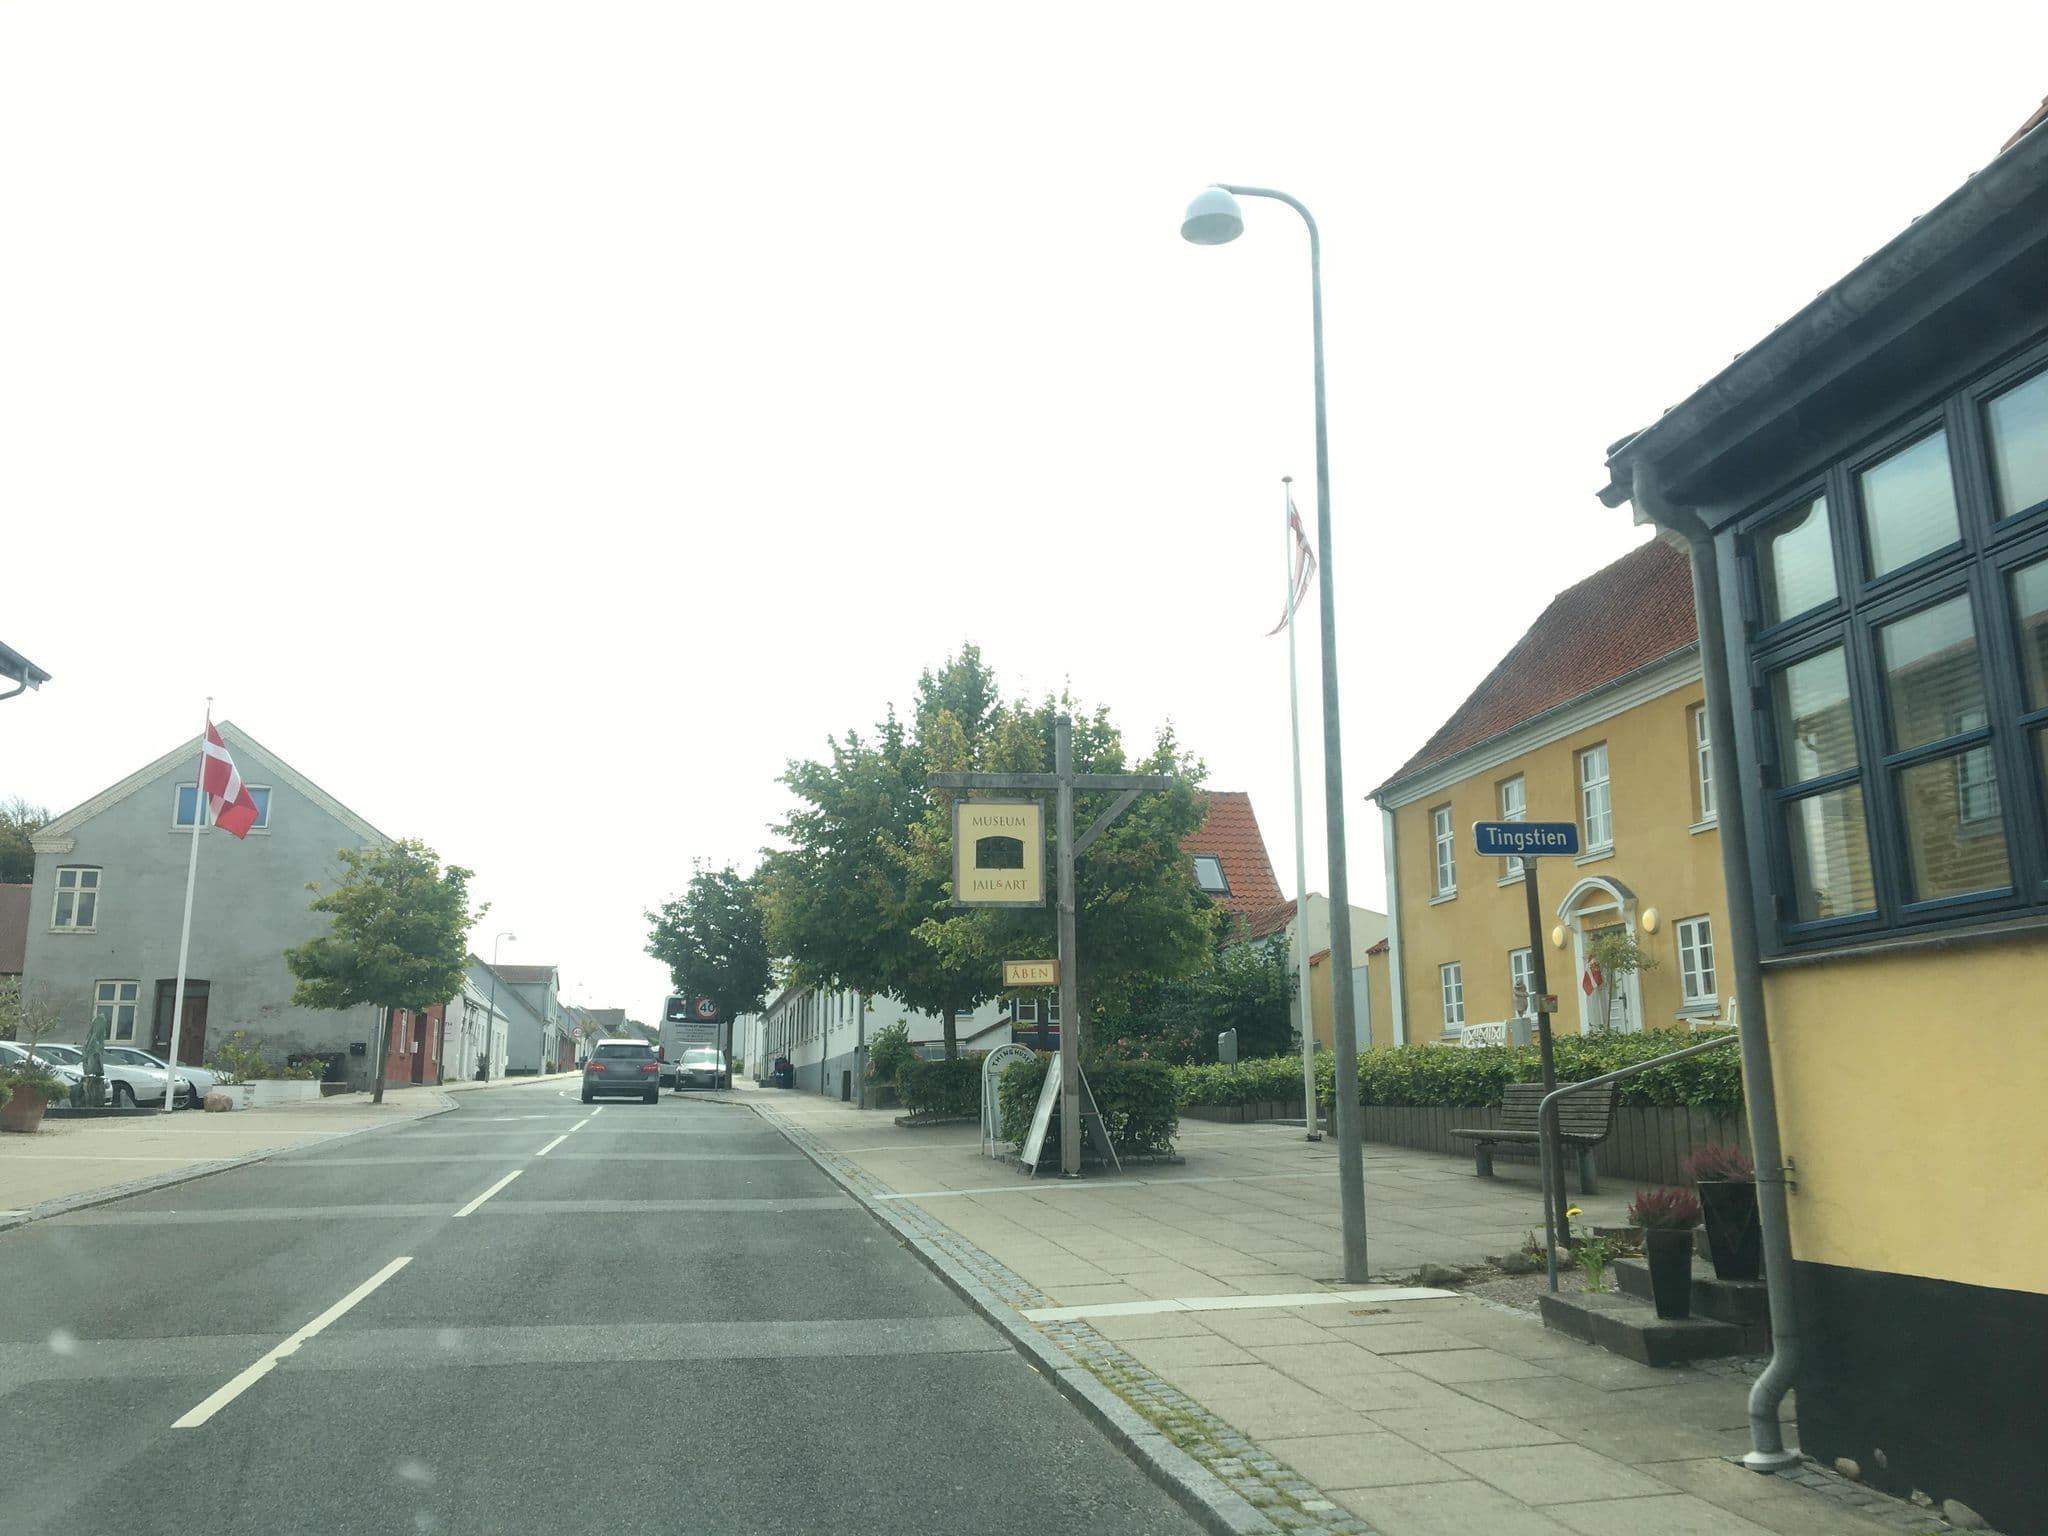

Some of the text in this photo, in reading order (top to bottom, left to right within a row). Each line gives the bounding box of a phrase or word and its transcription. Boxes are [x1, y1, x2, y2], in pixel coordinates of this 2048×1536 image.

[972, 816, 1026, 827] MUSEUM
[1485, 827, 1567, 851] Tingstien
[972, 879, 996, 892] JAIL
[1004, 879, 1028, 890] ART
[1012, 965, 1048, 979] ÅBEN
[700, 1001, 715, 1013] 40
